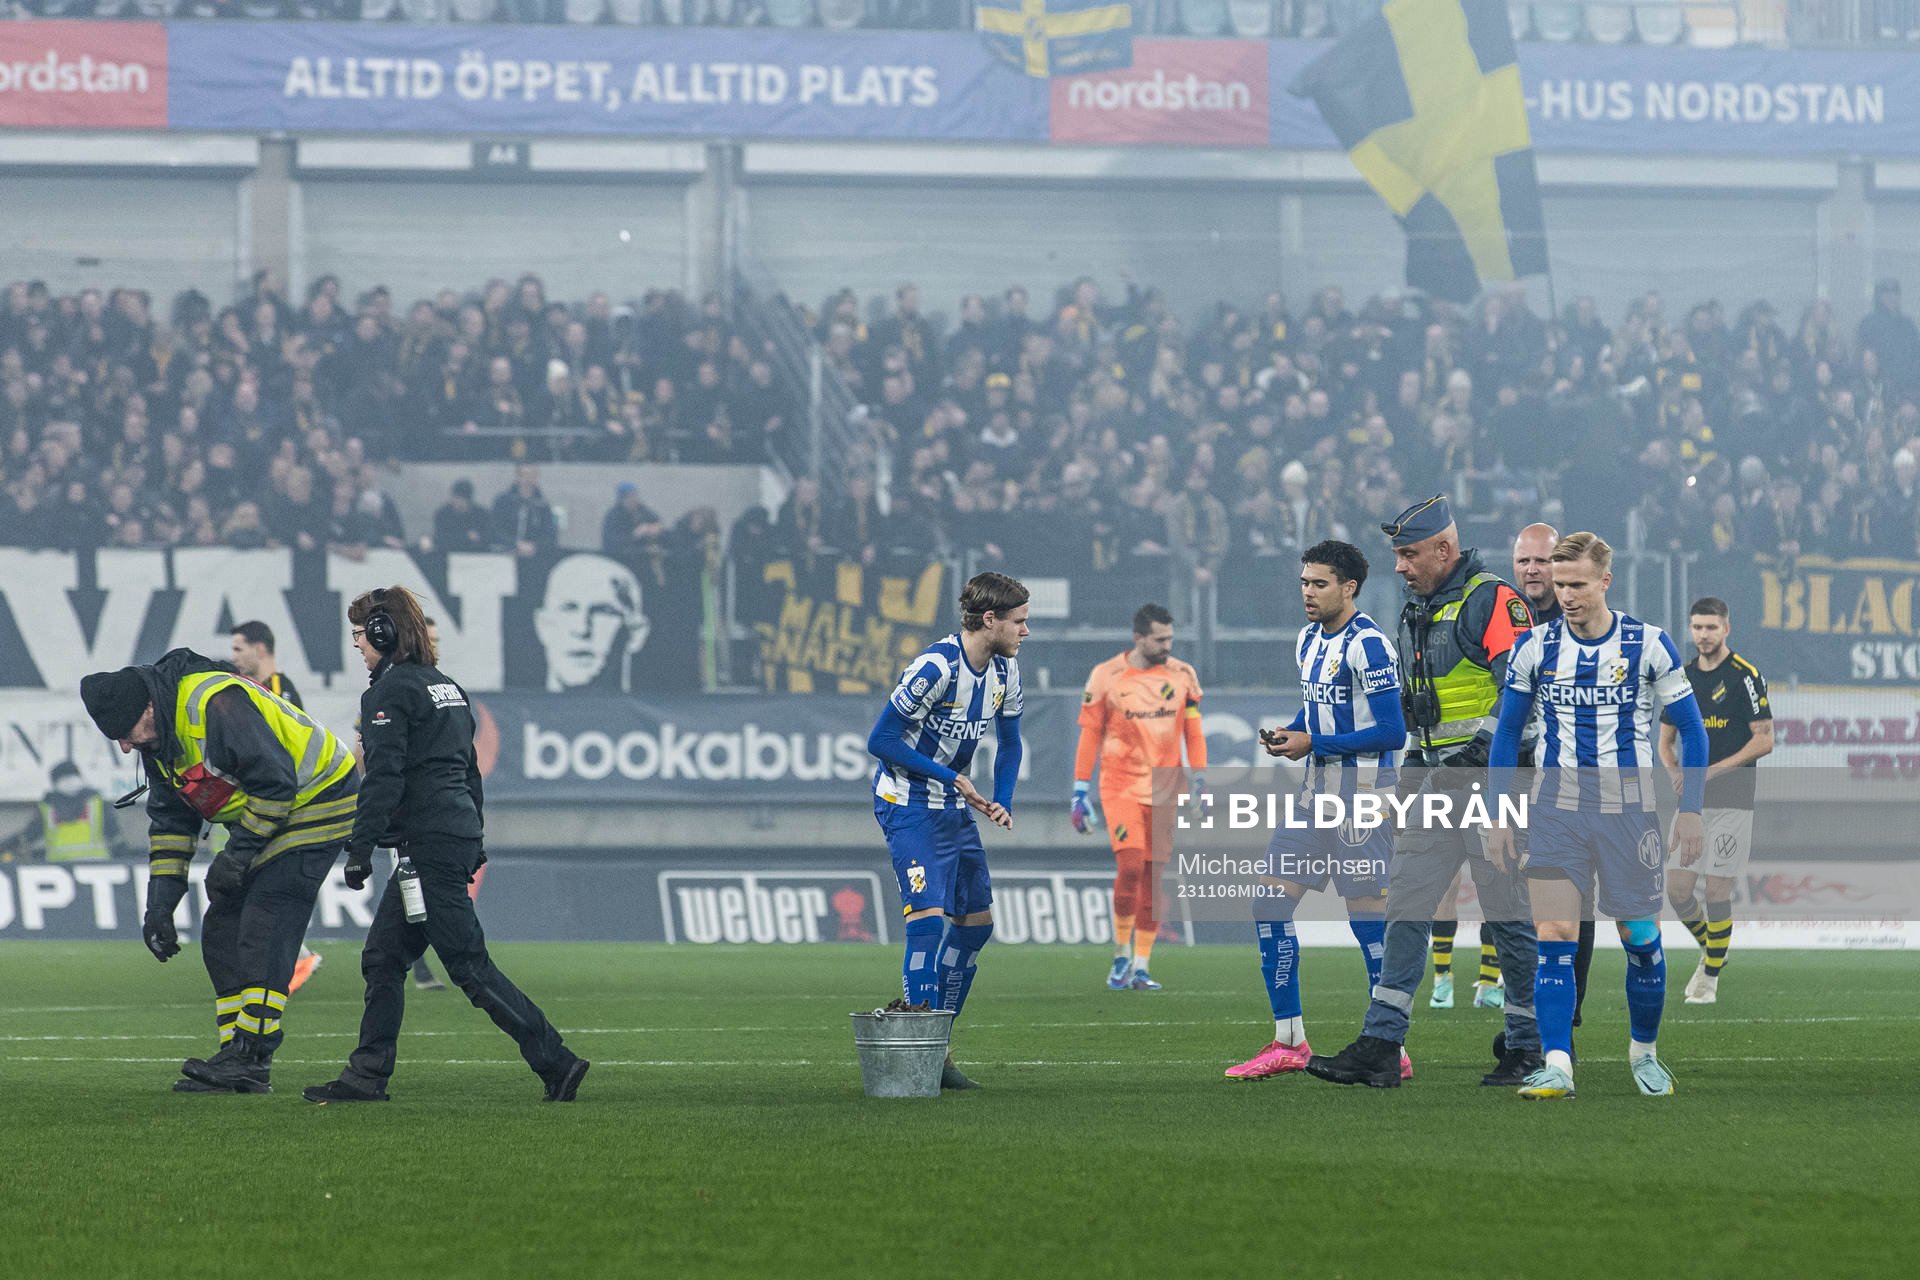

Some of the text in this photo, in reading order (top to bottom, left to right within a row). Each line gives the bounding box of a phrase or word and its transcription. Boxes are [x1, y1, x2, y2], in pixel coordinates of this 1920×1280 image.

[284, 49, 939, 113] ALLTID ÖPPET, ALLTID PLATS
[1068, 69, 1250, 111] nordstan
[1645, 81, 1885, 124] NORDSTAN
[1365, 664, 1395, 680] morris
[1367, 676, 1392, 690] law.
[1540, 683, 1635, 706] SERNEKE
[925, 713, 988, 741] SERNE
[1703, 715, 1730, 729] aller
[1773, 714, 1920, 745] TROLLH
[675, 875, 829, 944] weber
[991, 874, 1118, 945] webe
[943, 968, 964, 1011] SILFVERLO
